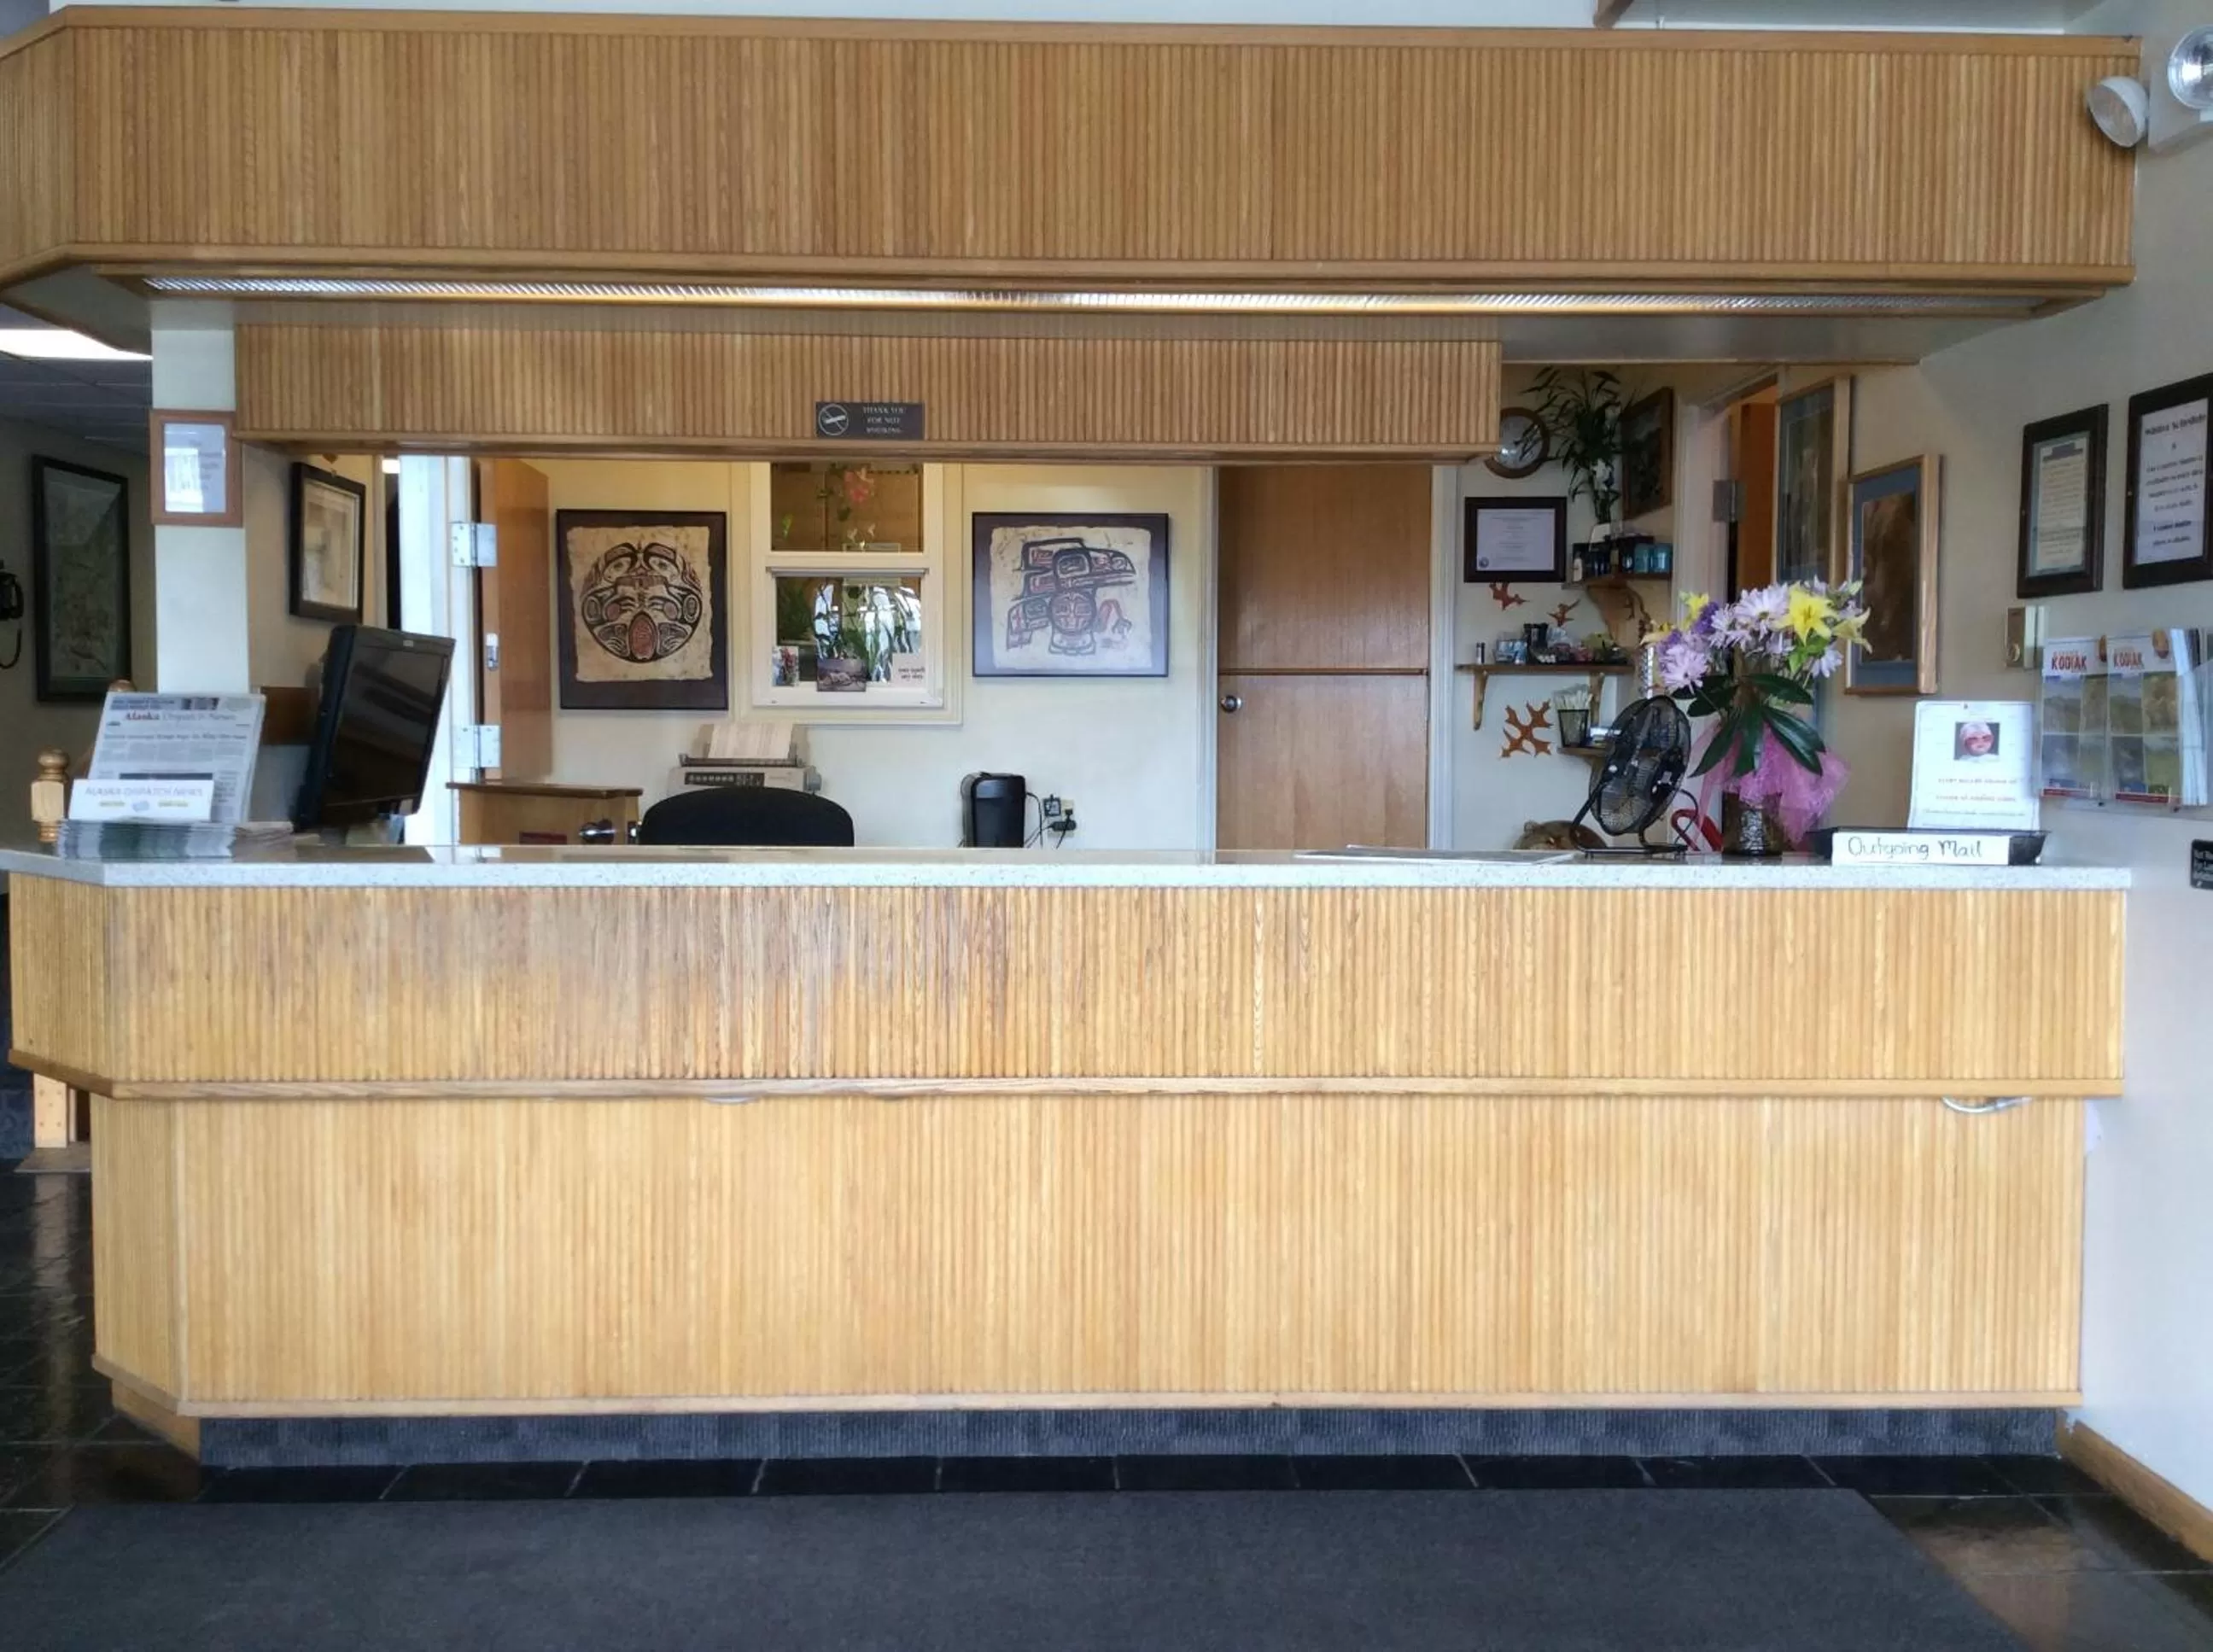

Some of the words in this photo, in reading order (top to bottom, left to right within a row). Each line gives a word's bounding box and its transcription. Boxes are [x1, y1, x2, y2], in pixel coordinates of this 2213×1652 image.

[2052, 655, 2087, 671] KODIAK
[125, 711, 161, 721] Alaska
[1848, 836, 1929, 861] Outgoing
[1937, 839, 1982, 858] Mail
